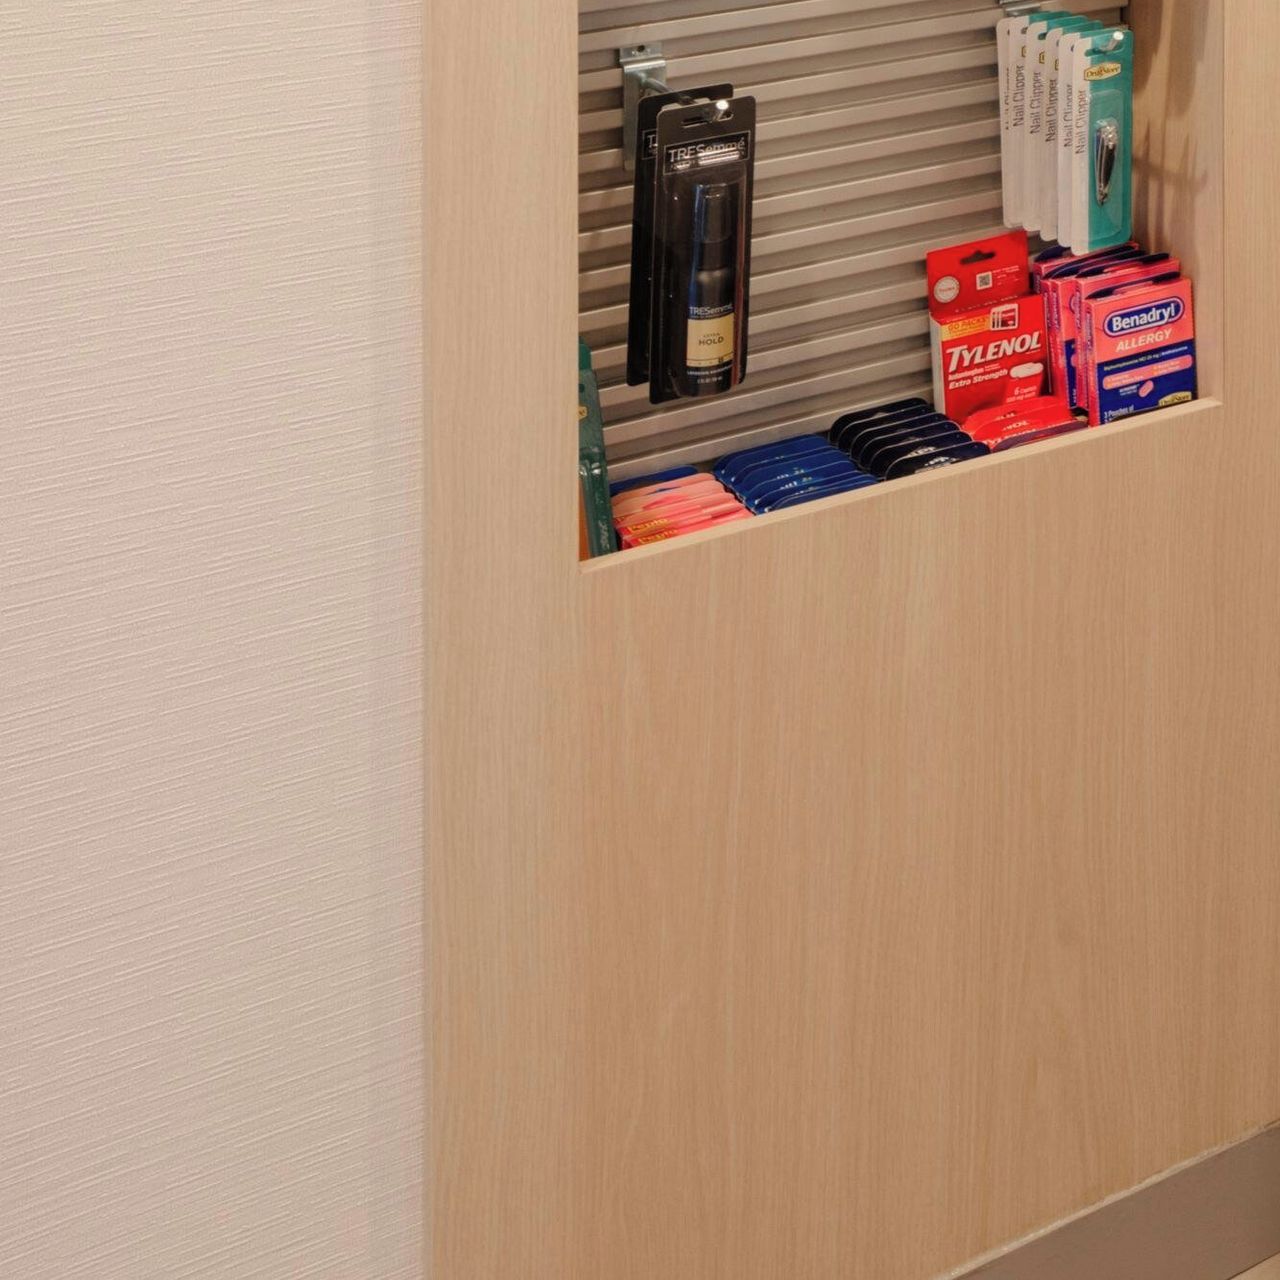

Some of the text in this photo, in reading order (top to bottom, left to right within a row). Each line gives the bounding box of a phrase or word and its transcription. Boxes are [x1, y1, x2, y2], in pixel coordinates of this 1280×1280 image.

[1030, 72, 1044, 109] Clipper
[1075, 90, 1088, 128] Clipper
[668, 136, 745, 162] TRESemmé
[1112, 303, 1176, 332] Benadryl
[698, 336, 725, 346] HOLD
[946, 331, 1042, 373] TYLENOL
[1116, 328, 1173, 352] ALLERGY
[948, 369, 1008, 390] Extra Strength
